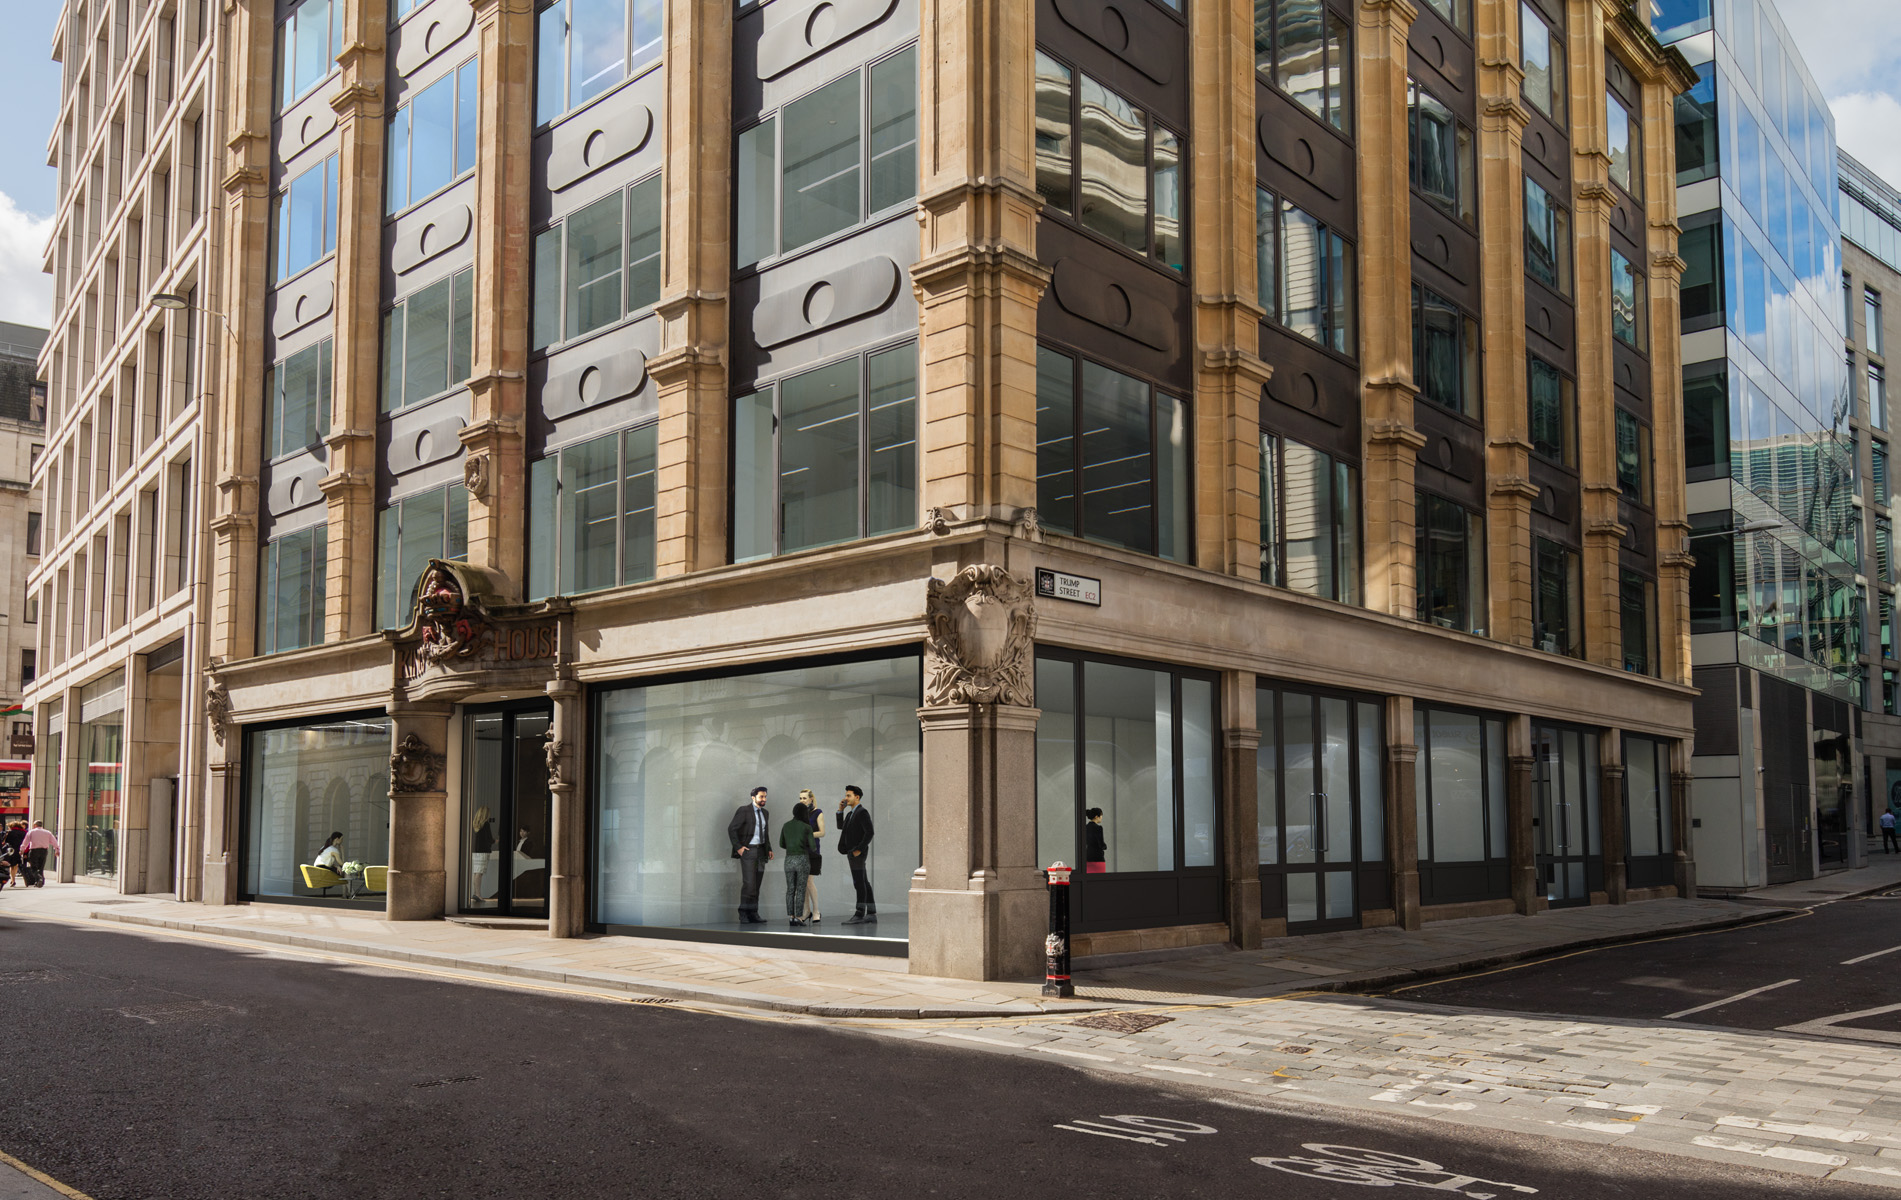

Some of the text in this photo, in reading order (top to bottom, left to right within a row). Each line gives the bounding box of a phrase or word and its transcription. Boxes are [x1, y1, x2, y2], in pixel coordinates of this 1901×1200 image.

[1059, 577, 1080, 588] TRUMP
[1059, 586, 1080, 597] STREET
[1085, 591, 1096, 600] EC2
